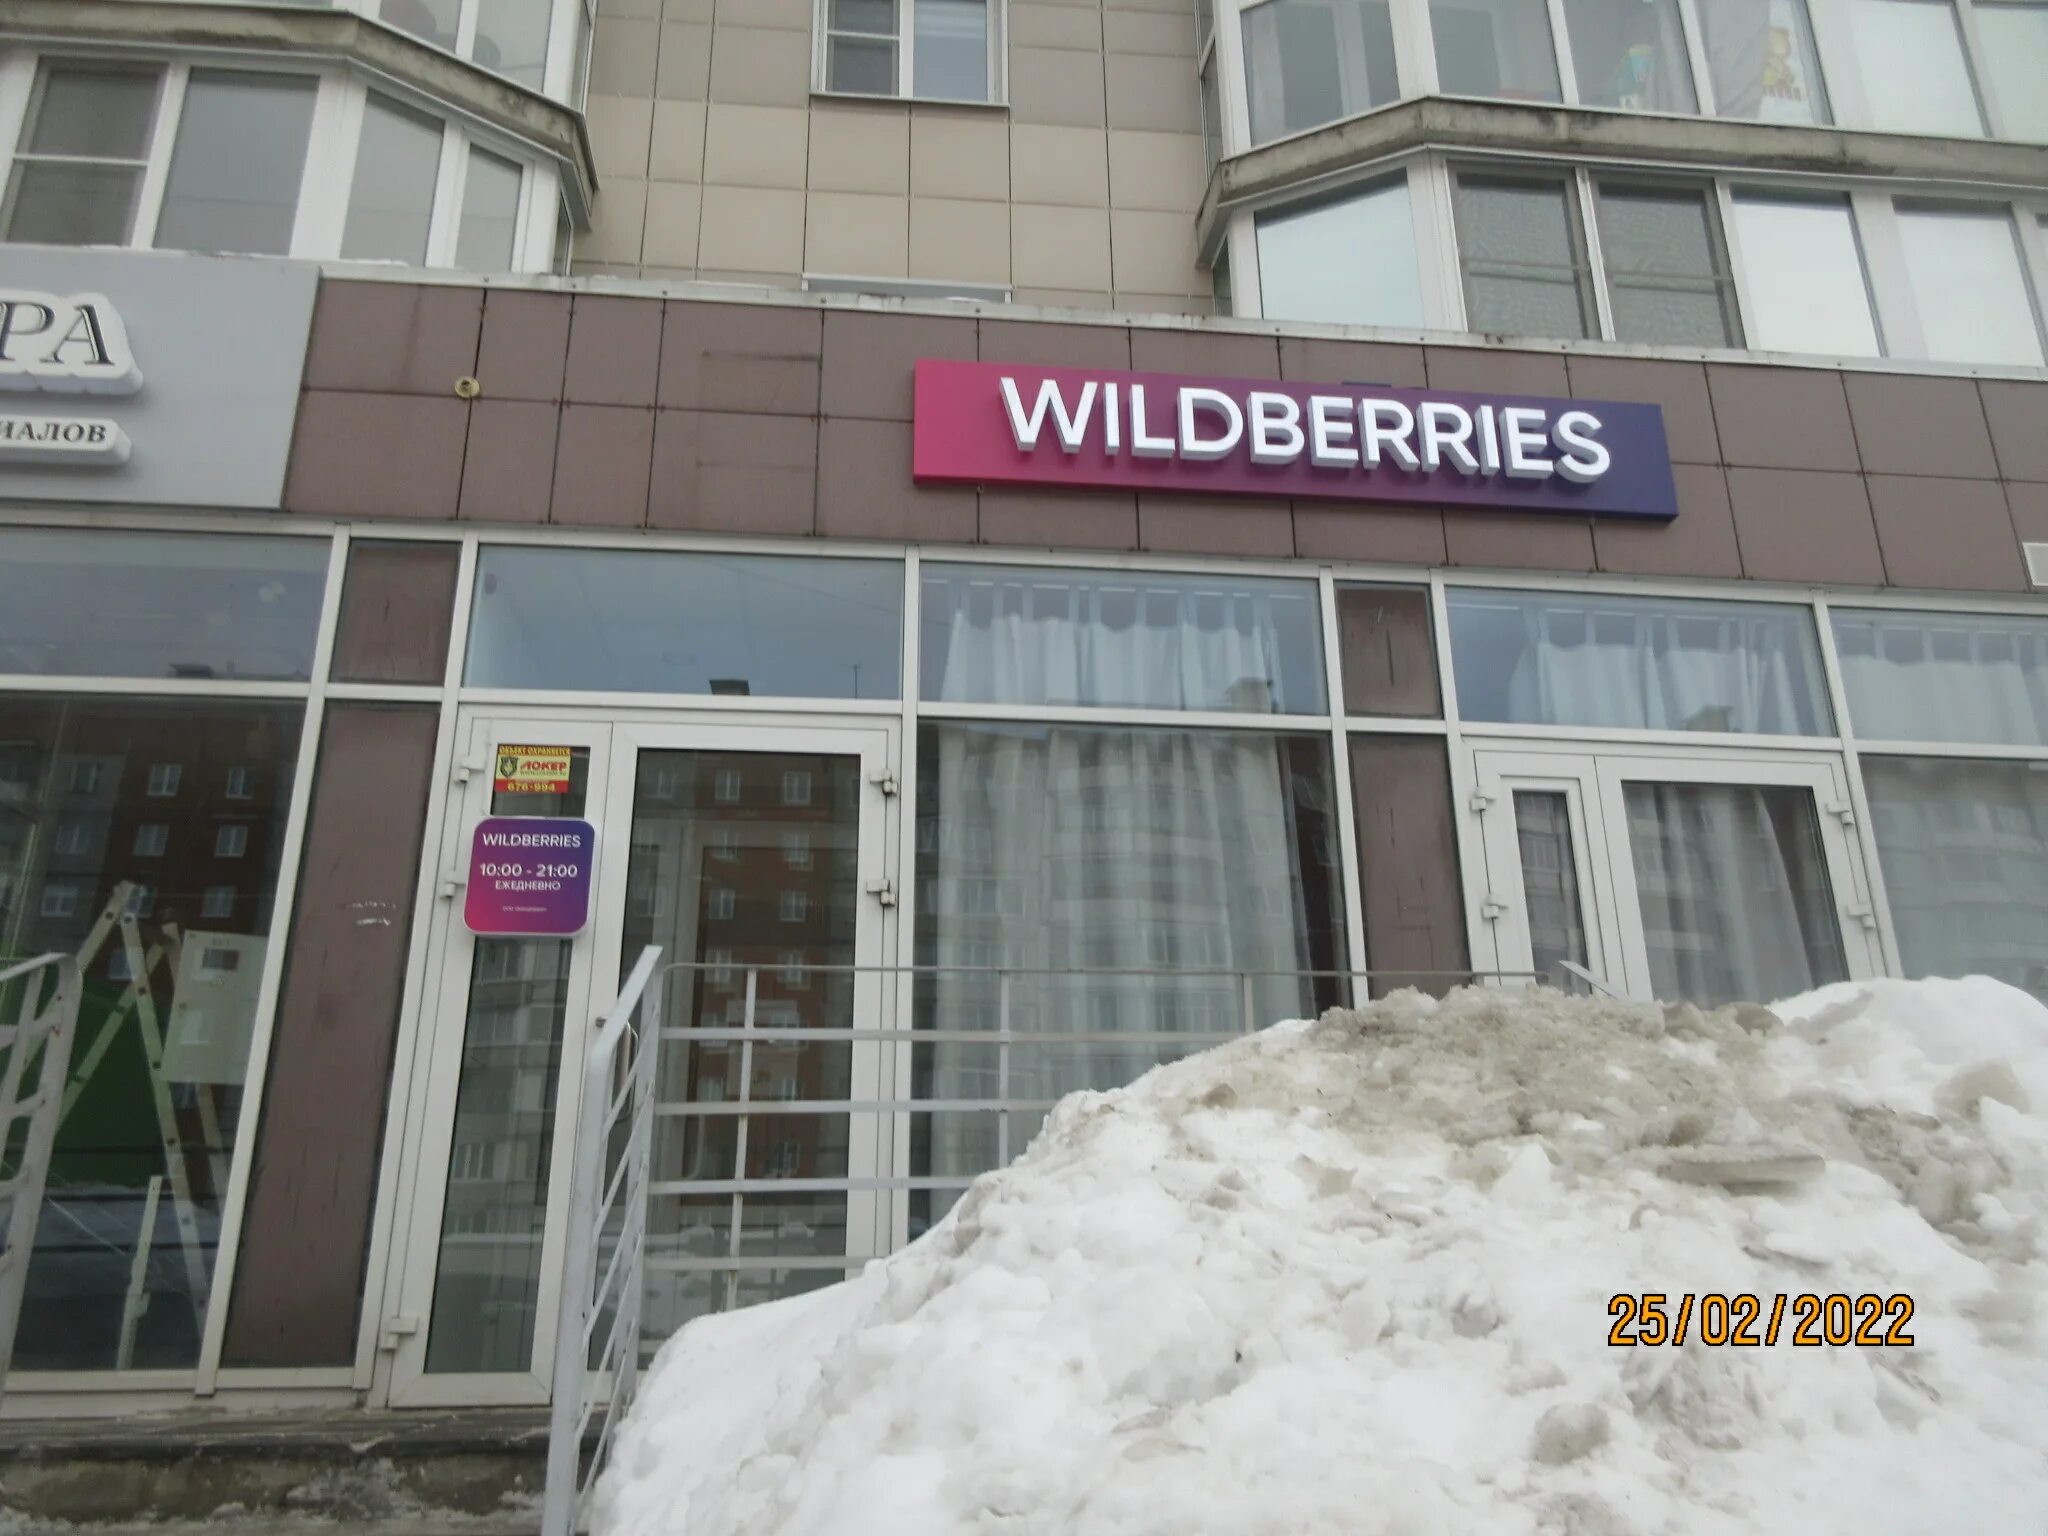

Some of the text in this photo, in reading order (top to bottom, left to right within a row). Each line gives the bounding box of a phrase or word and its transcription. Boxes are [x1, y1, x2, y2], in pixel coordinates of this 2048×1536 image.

[1000, 377, 1611, 484] WILDBERRIES
[482, 833, 582, 848] WILDBERRIES
[480, 863, 523, 877] 10:00
[536, 864, 578, 878] 21:00
[495, 880, 561, 892] ЕЖЕДНЕВНО
